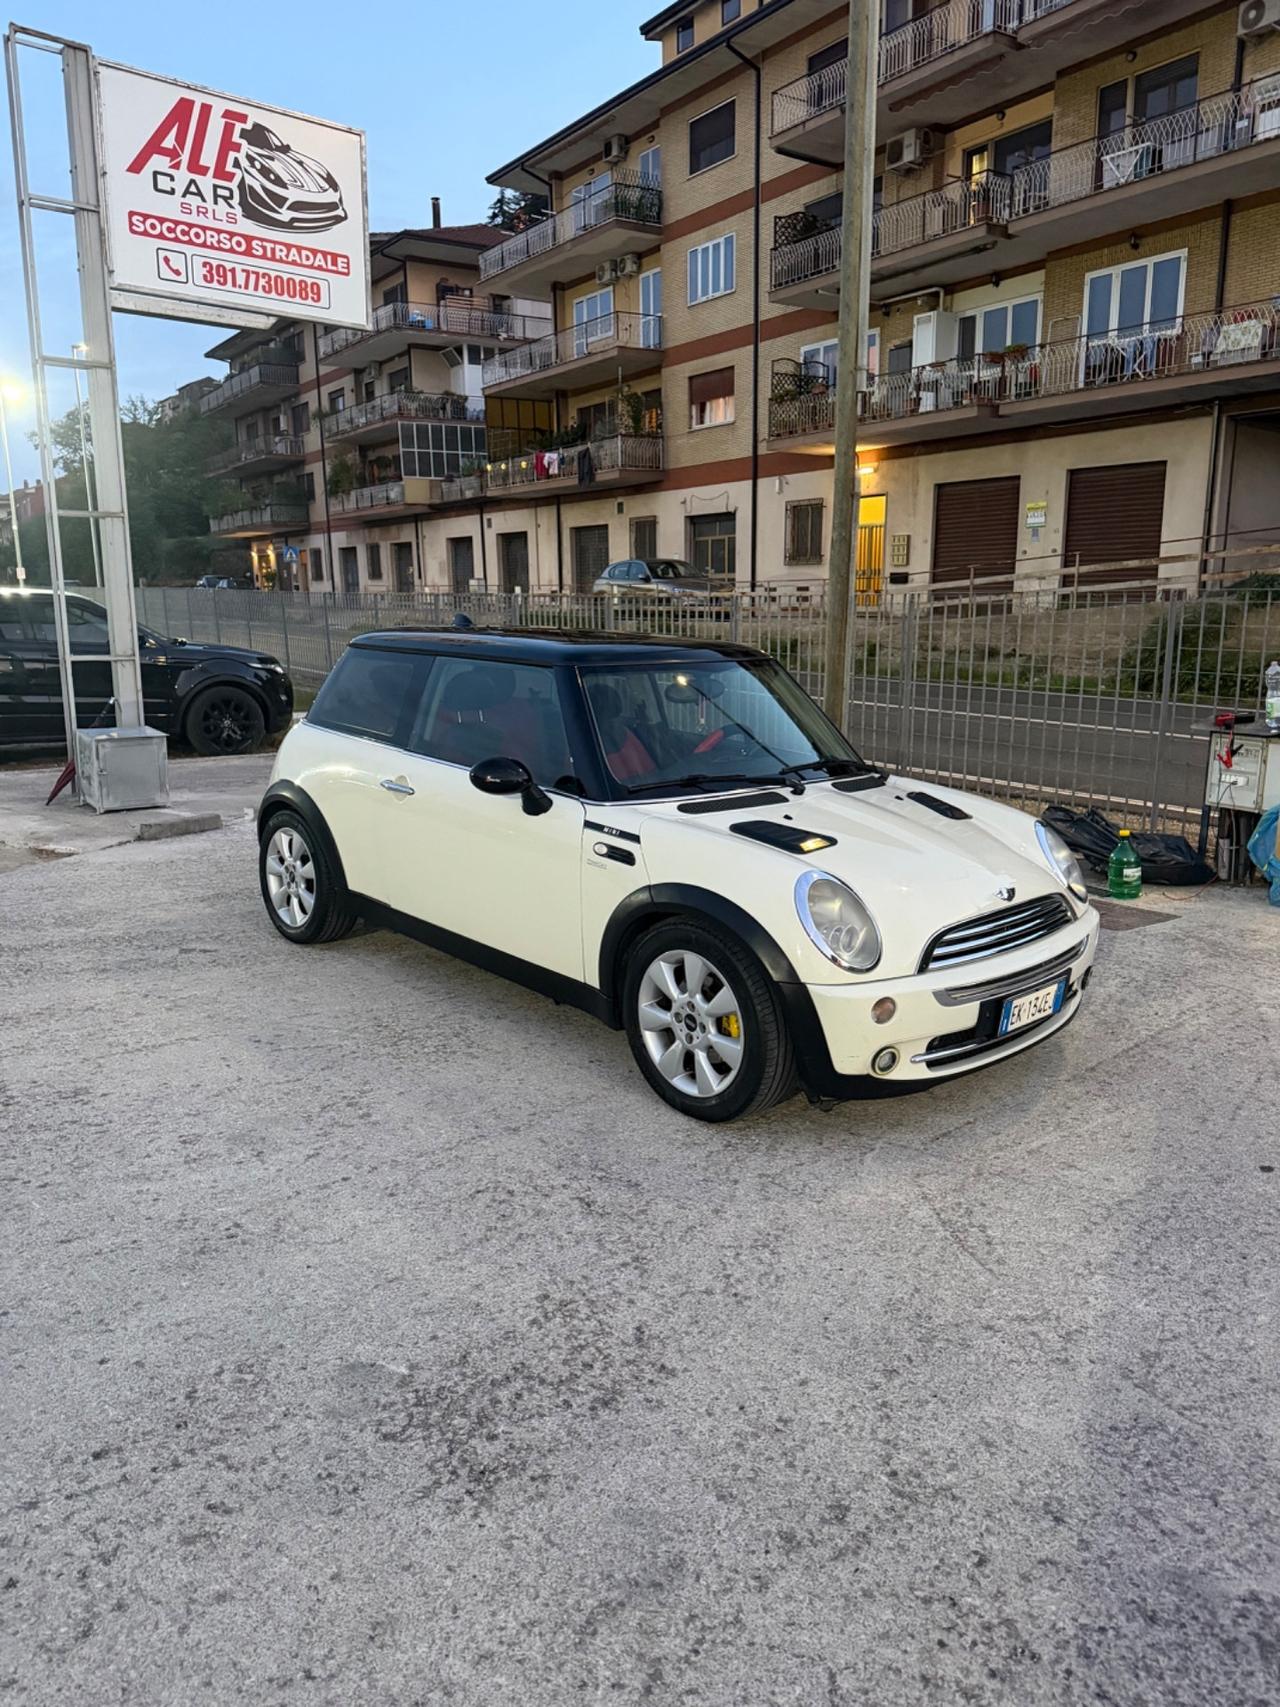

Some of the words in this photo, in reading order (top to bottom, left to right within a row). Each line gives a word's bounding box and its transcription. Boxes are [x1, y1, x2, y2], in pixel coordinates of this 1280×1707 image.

[126, 97, 248, 183] ALE
[152, 170, 236, 209] CAR
[180, 202, 238, 225] SRLS
[131, 215, 247, 252] SOCCORSO
[251, 242, 348, 273] STRADALE
[202, 261, 321, 303] 391.7730089
